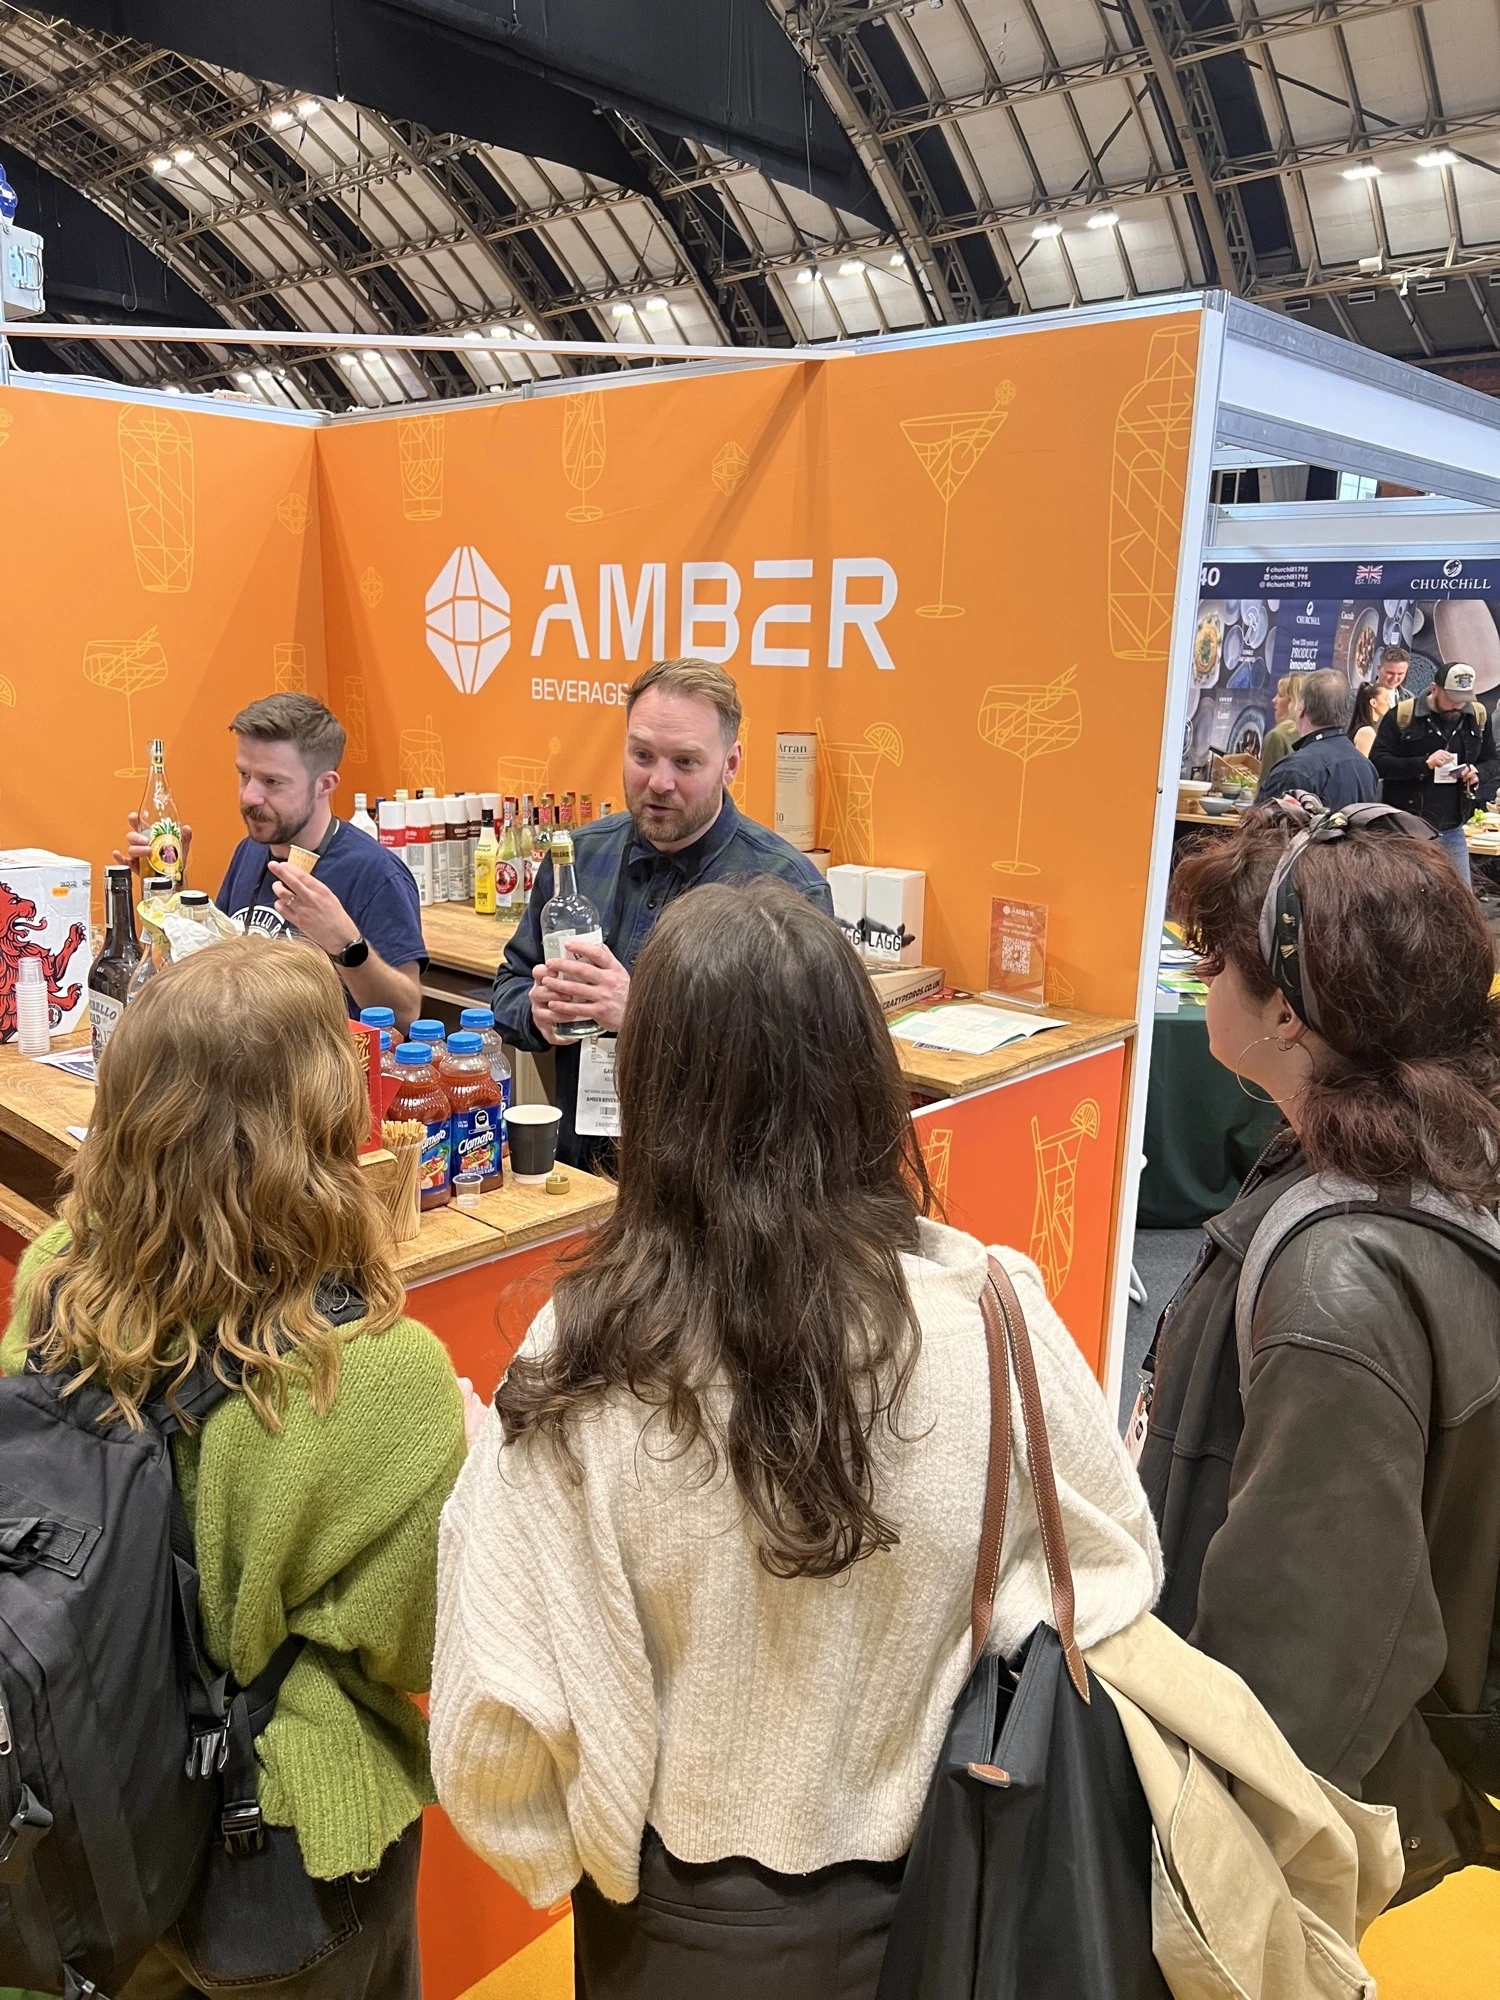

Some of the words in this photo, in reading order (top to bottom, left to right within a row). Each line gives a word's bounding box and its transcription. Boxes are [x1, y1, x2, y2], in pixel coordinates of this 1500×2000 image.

[530, 557, 898, 670] AMBER
[1290, 647, 1319, 659] PRODUCT
[1289, 659, 1316, 670] innovation
[778, 743, 807, 753] Arran
[1010, 907, 1035, 917] AMBER
[845, 929, 860, 946] GG
[868, 930, 901, 952] LAGG
[882, 979, 941, 1010] CRAZYPEDROS.CO.UK
[421, 1129, 446, 1150] amato
[457, 1130, 494, 1155] Clamato
